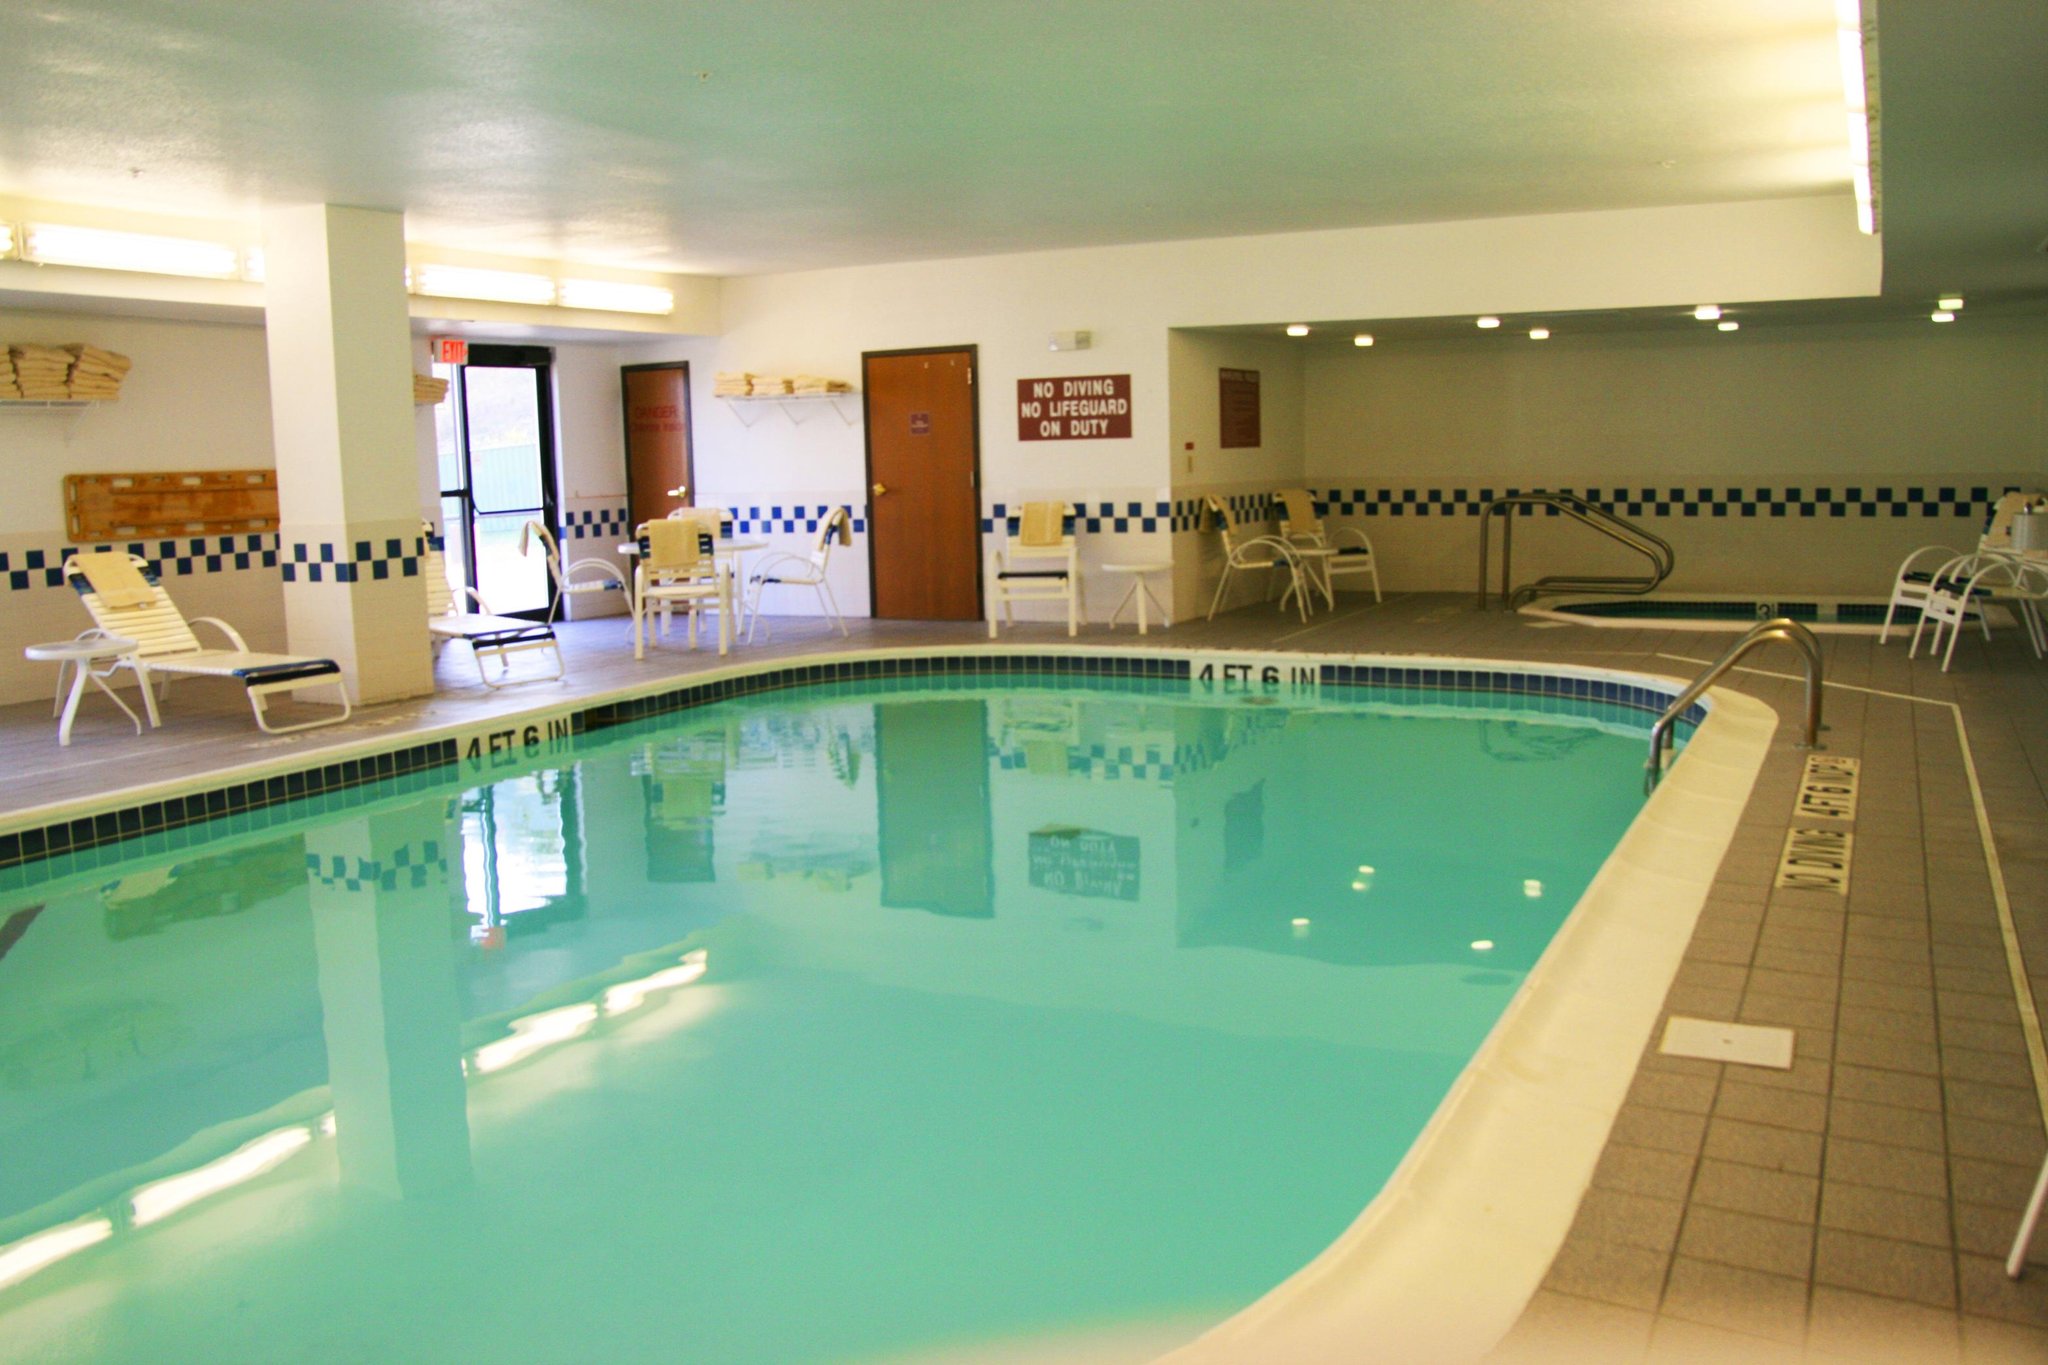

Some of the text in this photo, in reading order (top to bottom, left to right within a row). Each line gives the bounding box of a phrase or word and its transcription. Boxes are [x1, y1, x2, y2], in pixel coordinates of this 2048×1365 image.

[442, 340, 464, 362] EXIT
[1033, 378, 1114, 398] NO DIVING
[1021, 399, 1127, 418] NO LIFEGUARD
[1039, 419, 1108, 437] ON DUTY
[1199, 664, 1315, 685] 4 FT 6 IN
[466, 718, 568, 759] 4 FT 6 IN
[1781, 828, 1845, 892] NO DIVING
